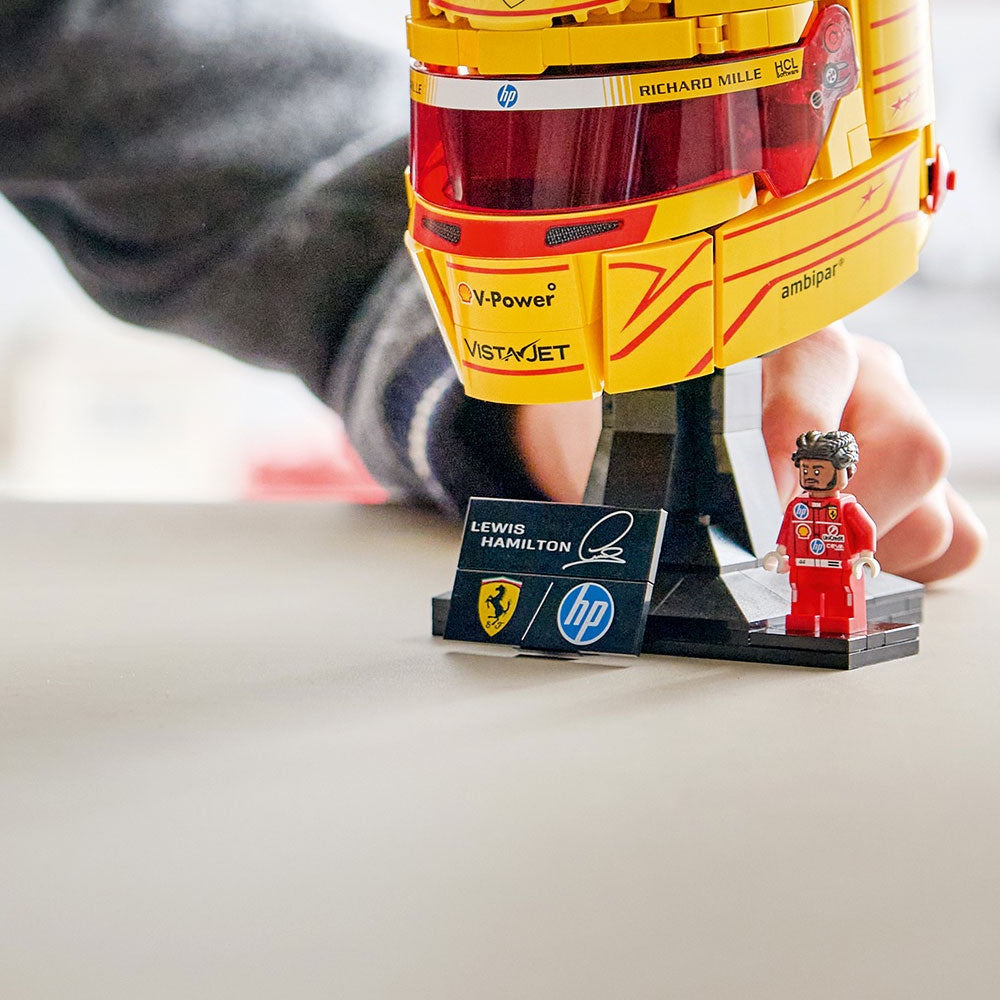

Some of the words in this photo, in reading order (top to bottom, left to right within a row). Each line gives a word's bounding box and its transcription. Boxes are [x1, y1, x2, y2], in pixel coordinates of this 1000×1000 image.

[774, 57, 798, 73] HCL
[639, 77, 712, 97] RICHARD
[718, 68, 762, 87] MILLE
[499, 84, 517, 108] hp
[473, 289, 555, 308] V-Power
[471, 520, 526, 535] LEWIS
[481, 536, 571, 552] HAMILTON
[810, 539, 824, 554] hp
[564, 583, 609, 643] hp
